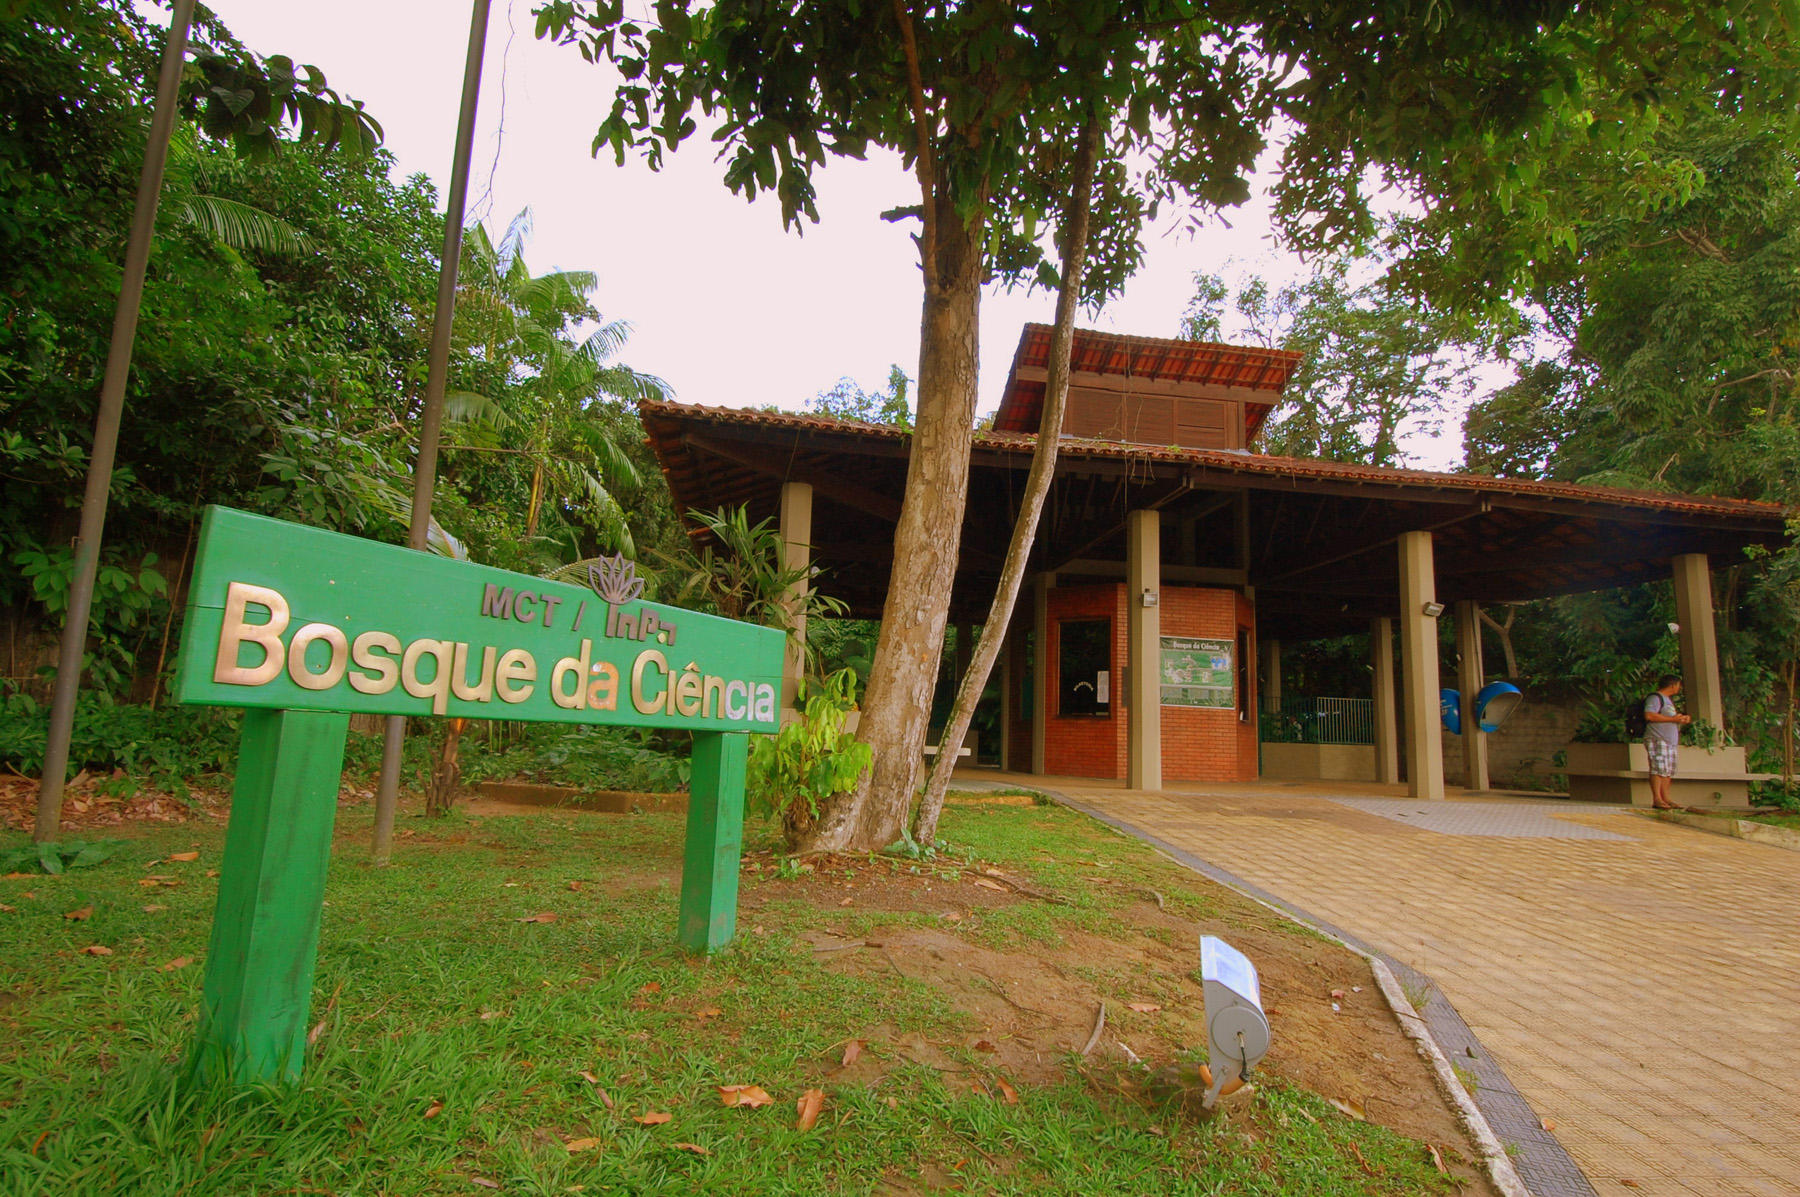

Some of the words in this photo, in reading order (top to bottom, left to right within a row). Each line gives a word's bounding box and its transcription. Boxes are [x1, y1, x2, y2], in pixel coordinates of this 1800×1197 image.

[482, 583, 563, 627] MCT
[213, 581, 538, 716] Bosque
[551, 639, 620, 711] da
[631, 649, 776, 723] Ciência
